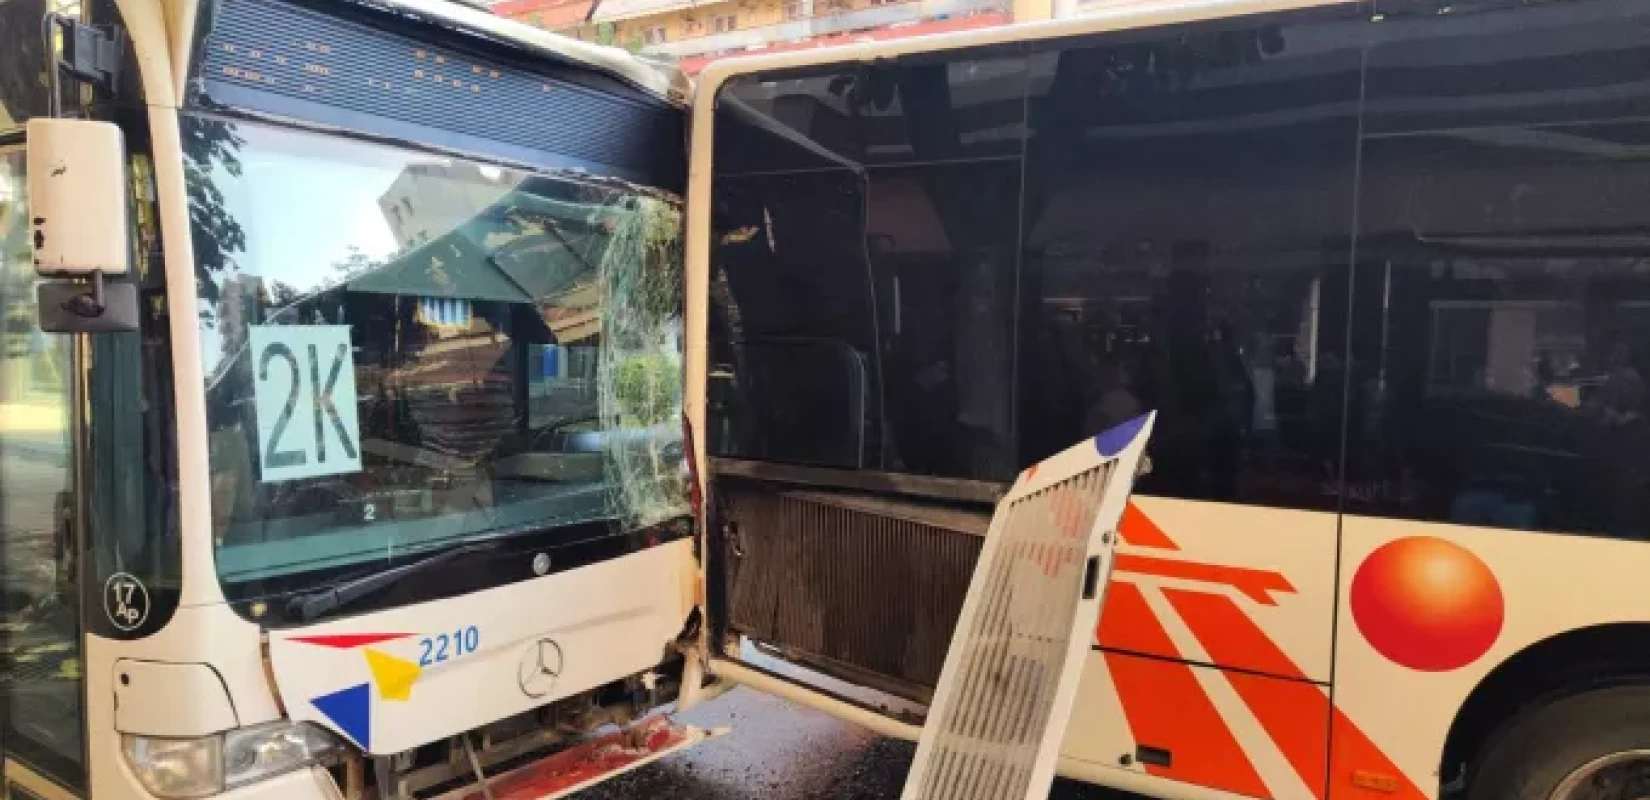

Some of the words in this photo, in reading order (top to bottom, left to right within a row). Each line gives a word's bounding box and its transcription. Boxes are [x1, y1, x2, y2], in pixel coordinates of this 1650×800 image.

[259, 341, 358, 468] 2K
[364, 503, 375, 519] 2
[114, 582, 134, 604] 17
[419, 625, 479, 667] 2210
